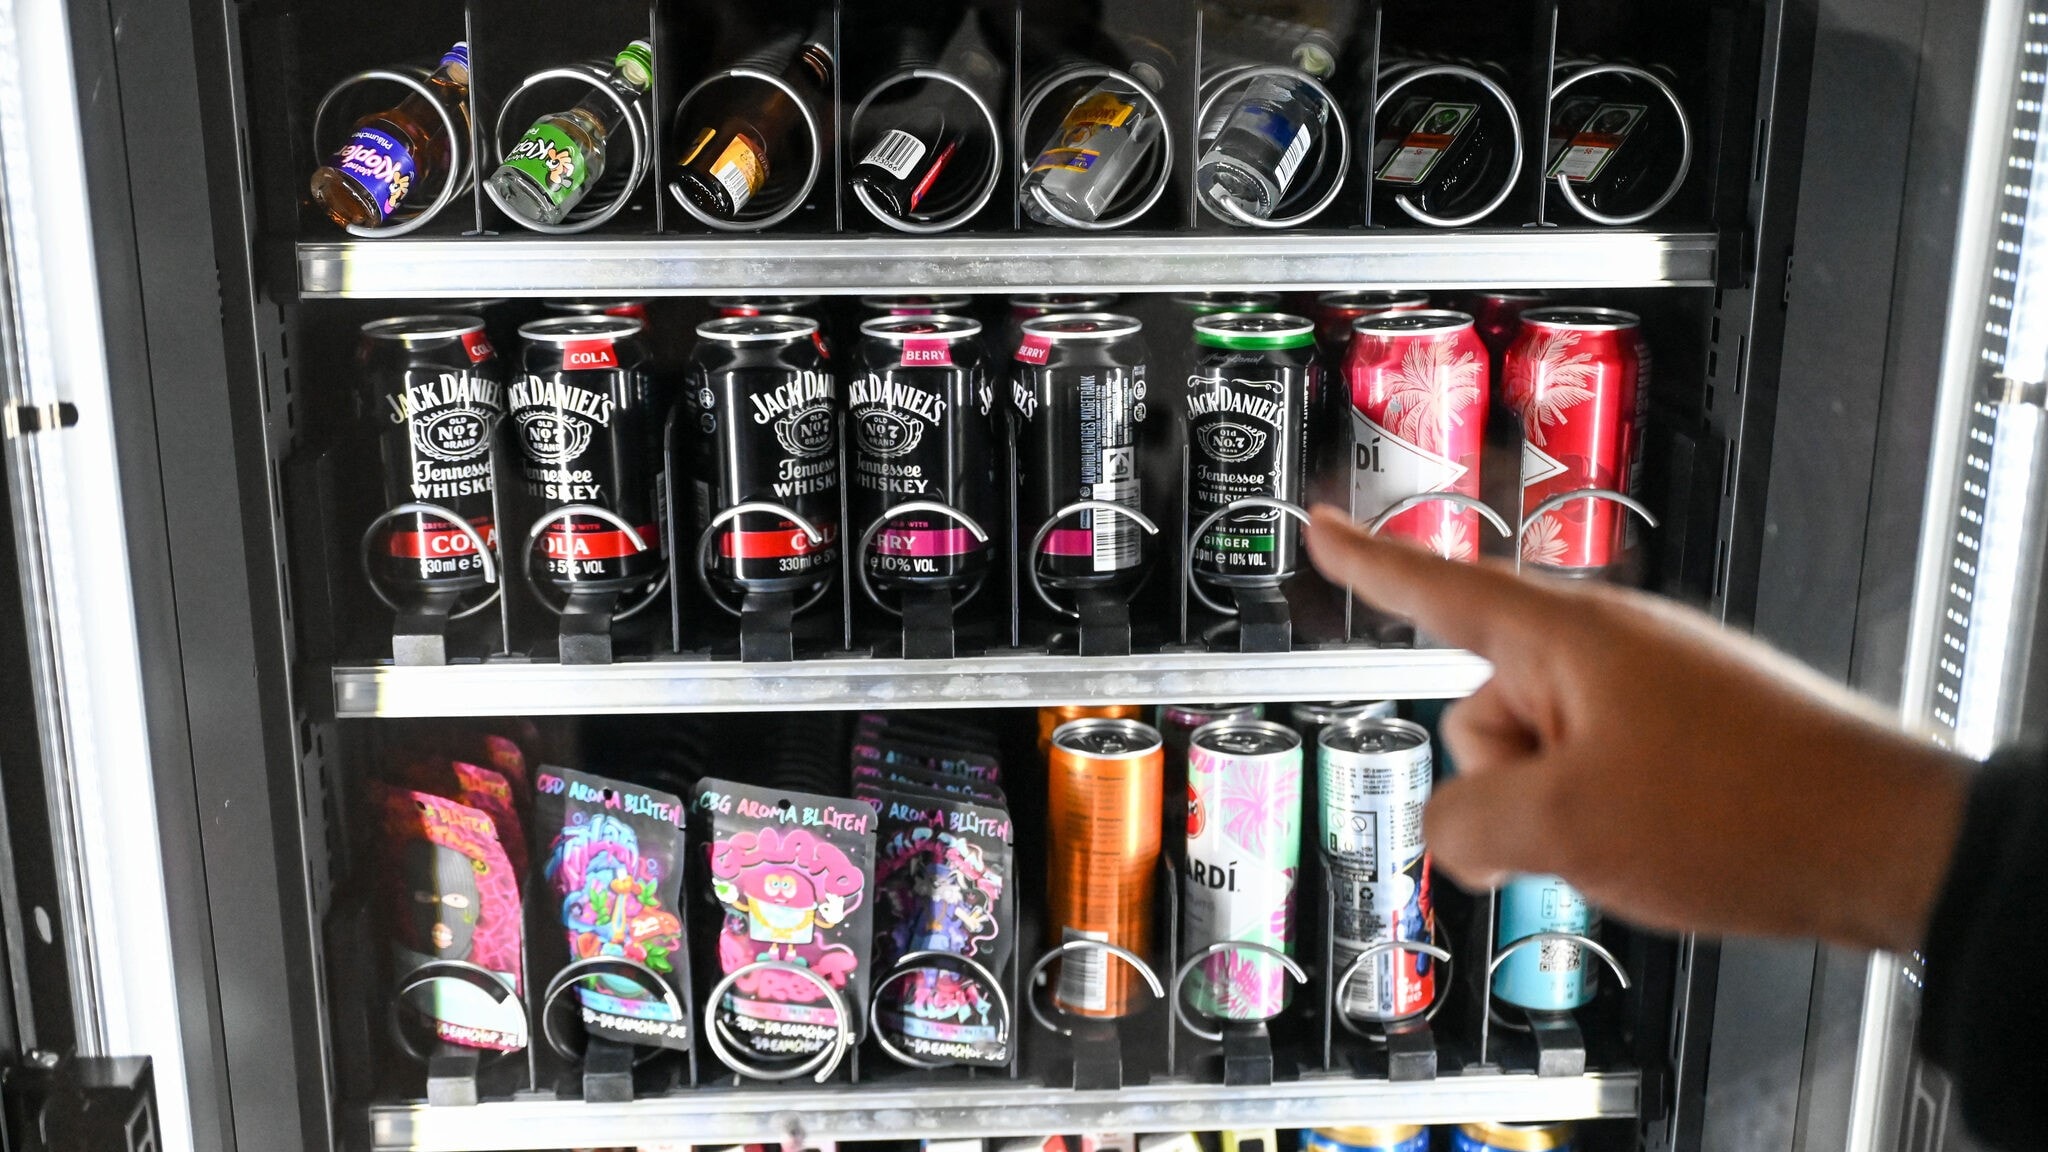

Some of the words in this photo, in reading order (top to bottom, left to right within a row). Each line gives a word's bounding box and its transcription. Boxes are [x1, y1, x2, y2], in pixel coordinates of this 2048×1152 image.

[570, 351, 610, 365] COLA
[905, 350, 946, 361] BERRY
[1018, 345, 1045, 360] BERRY
[386, 381, 442, 424] JACK
[438, 372, 503, 411] DANIEL
[508, 380, 530, 415] ACK
[528, 374, 616, 426] DANIEL'S
[749, 370, 803, 425] JACK
[803, 370, 836, 401] DAN
[848, 379, 871, 411] ACK
[868, 371, 948, 427] DANIEL'S
[1077, 375, 1096, 421] MIXGETRÄNK
[1186, 389, 1220, 421] JACK
[1220, 386, 1286, 429] DANIEL'S
[449, 417, 467, 426] OLD
[537, 420, 554, 428] OLD
[809, 413, 824, 422] OLD
[873, 417, 888, 425] OLD
[443, 437, 476, 449] BRAND
[1219, 429, 1237, 438] Old
[1081, 421, 1097, 484] ALKOHOLHALTIGES
[1355, 436, 1380, 473] DÍ
[415, 460, 493, 484] Tennesse
[1197, 464, 1265, 485] Tennessee
[410, 477, 493, 499] WHISKE
[528, 484, 601, 500] HISKEY
[856, 475, 929, 496] HISKEY
[1198, 490, 1252, 504] WHIS
[538, 534, 591, 556] OLA
[790, 526, 838, 551] COL
[862, 534, 917, 551] RRY
[1203, 534, 1251, 549] GINGER
[471, 556, 483, 569] 5
[779, 557, 812, 573] 330ml
[881, 557, 912, 573] 10%
[914, 558, 940, 574] VOL.
[1229, 552, 1247, 566] 10%
[1248, 552, 1268, 567] VOL.
[623, 793, 683, 828] BLÜTEN
[699, 790, 732, 816] CBG
[736, 797, 798, 825] AROMA
[801, 806, 869, 836] BLÜTEN
[949, 810, 1009, 843] BLÜTEN
[1185, 859, 1239, 894] ARDÍ
